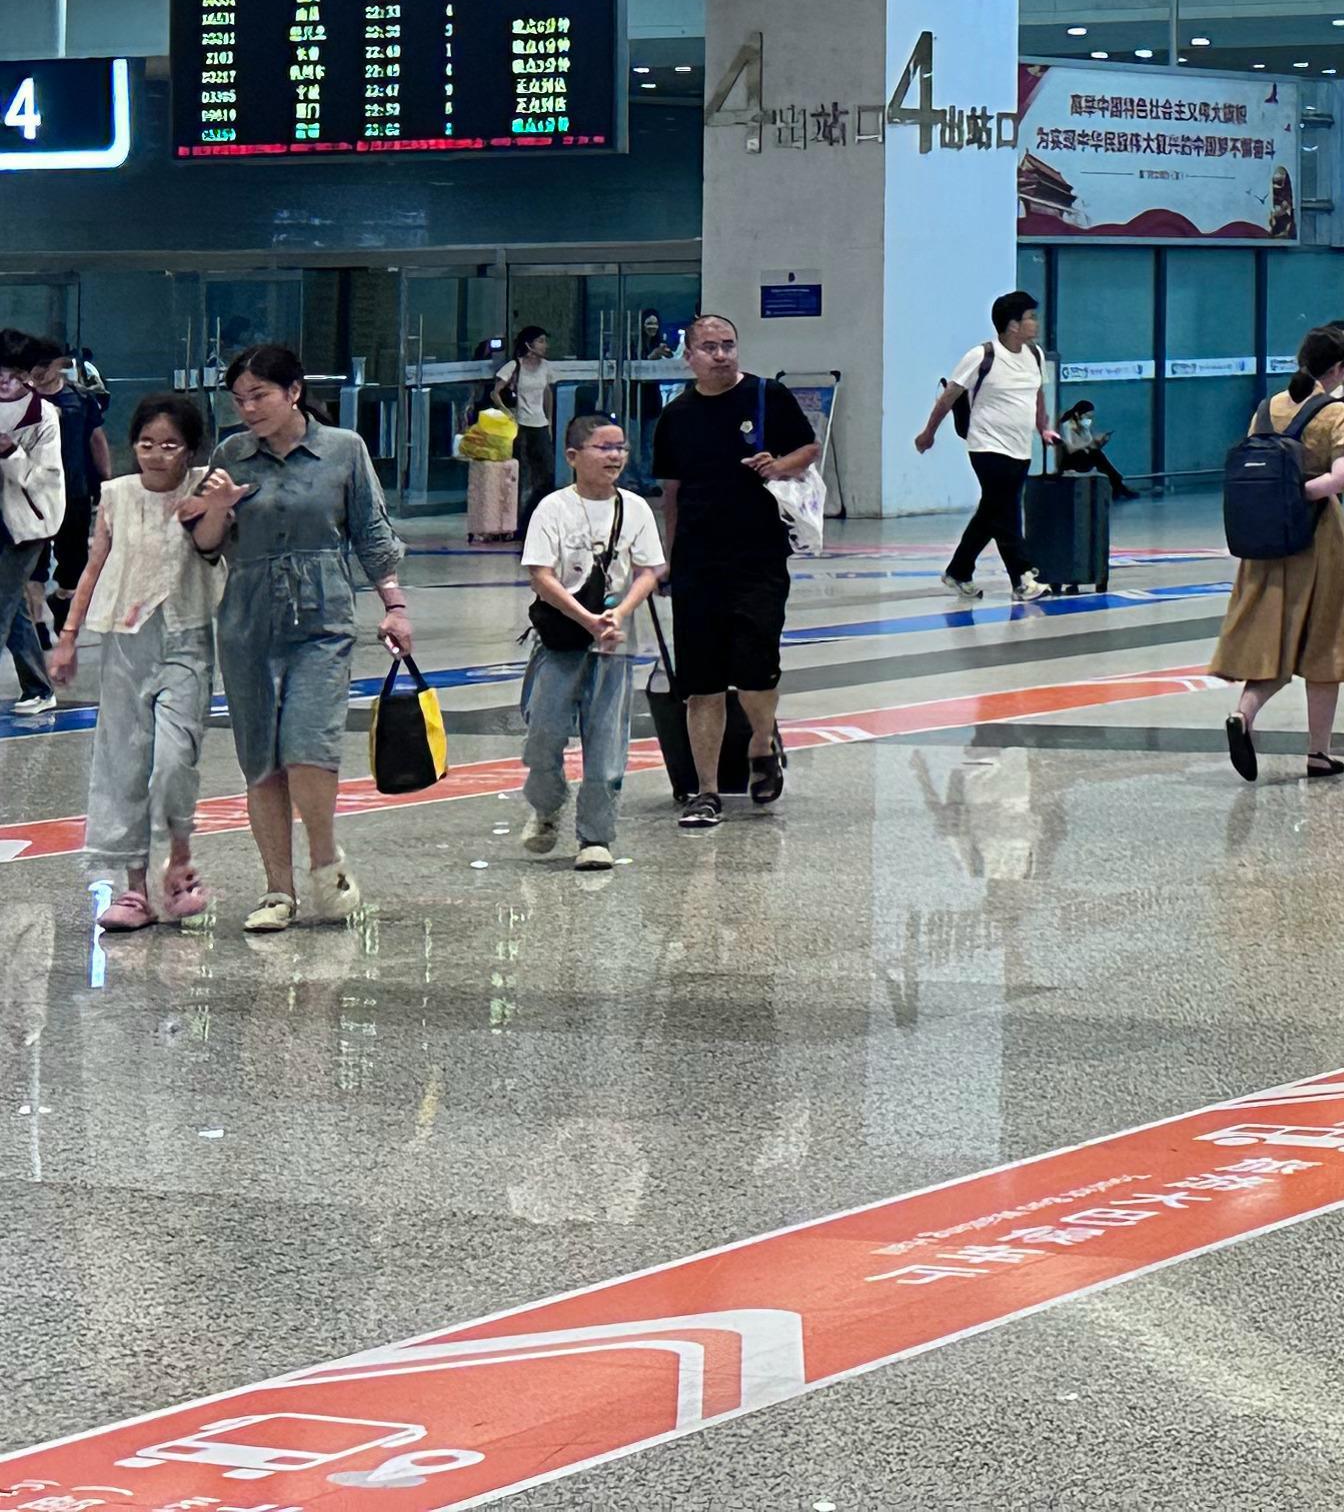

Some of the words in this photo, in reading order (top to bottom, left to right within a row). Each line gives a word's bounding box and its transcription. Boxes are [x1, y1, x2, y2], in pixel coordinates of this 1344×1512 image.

[4, 78, 42, 140] 4
[705, 31, 765, 154] 4
[887, 31, 947, 154] 4
[864, 1157, 1324, 1285] 旅游大巴候车厅
